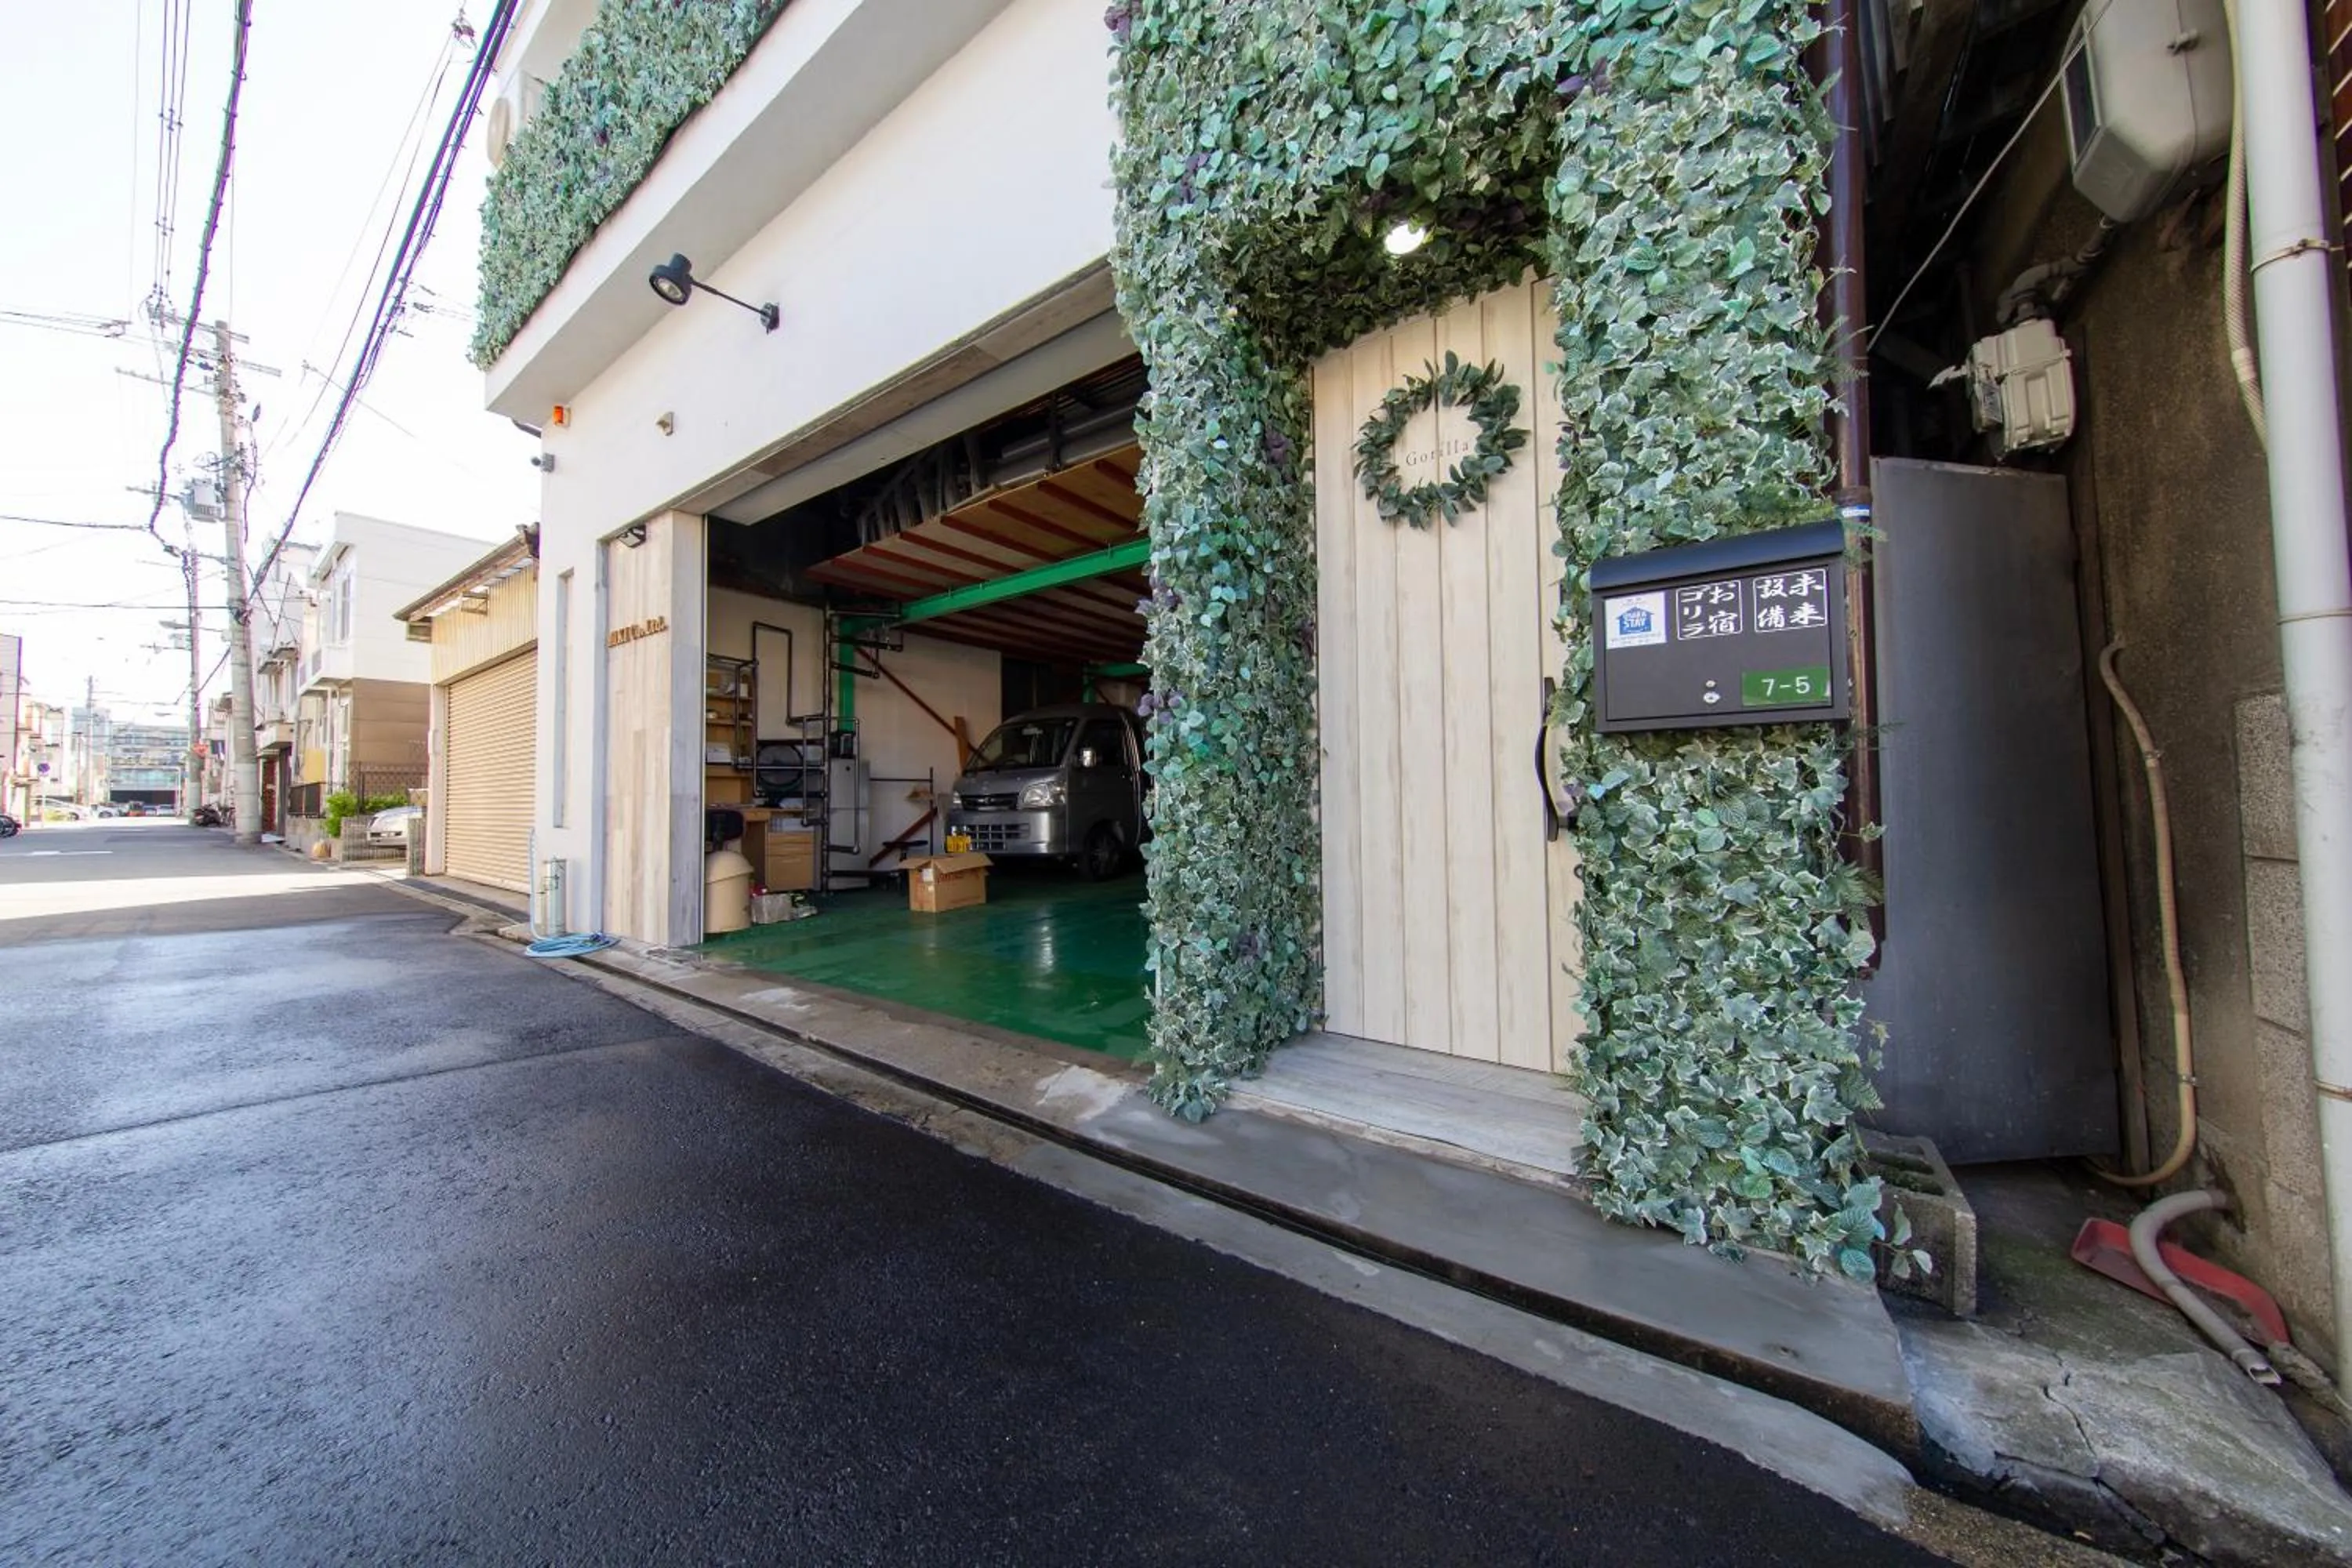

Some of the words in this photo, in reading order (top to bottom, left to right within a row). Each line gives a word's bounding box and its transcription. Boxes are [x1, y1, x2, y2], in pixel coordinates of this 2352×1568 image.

[1680, 586, 1711, 638] ゴリラ
[1708, 583, 1738, 634] お宿
[1761, 675, 1811, 697] 7-5
